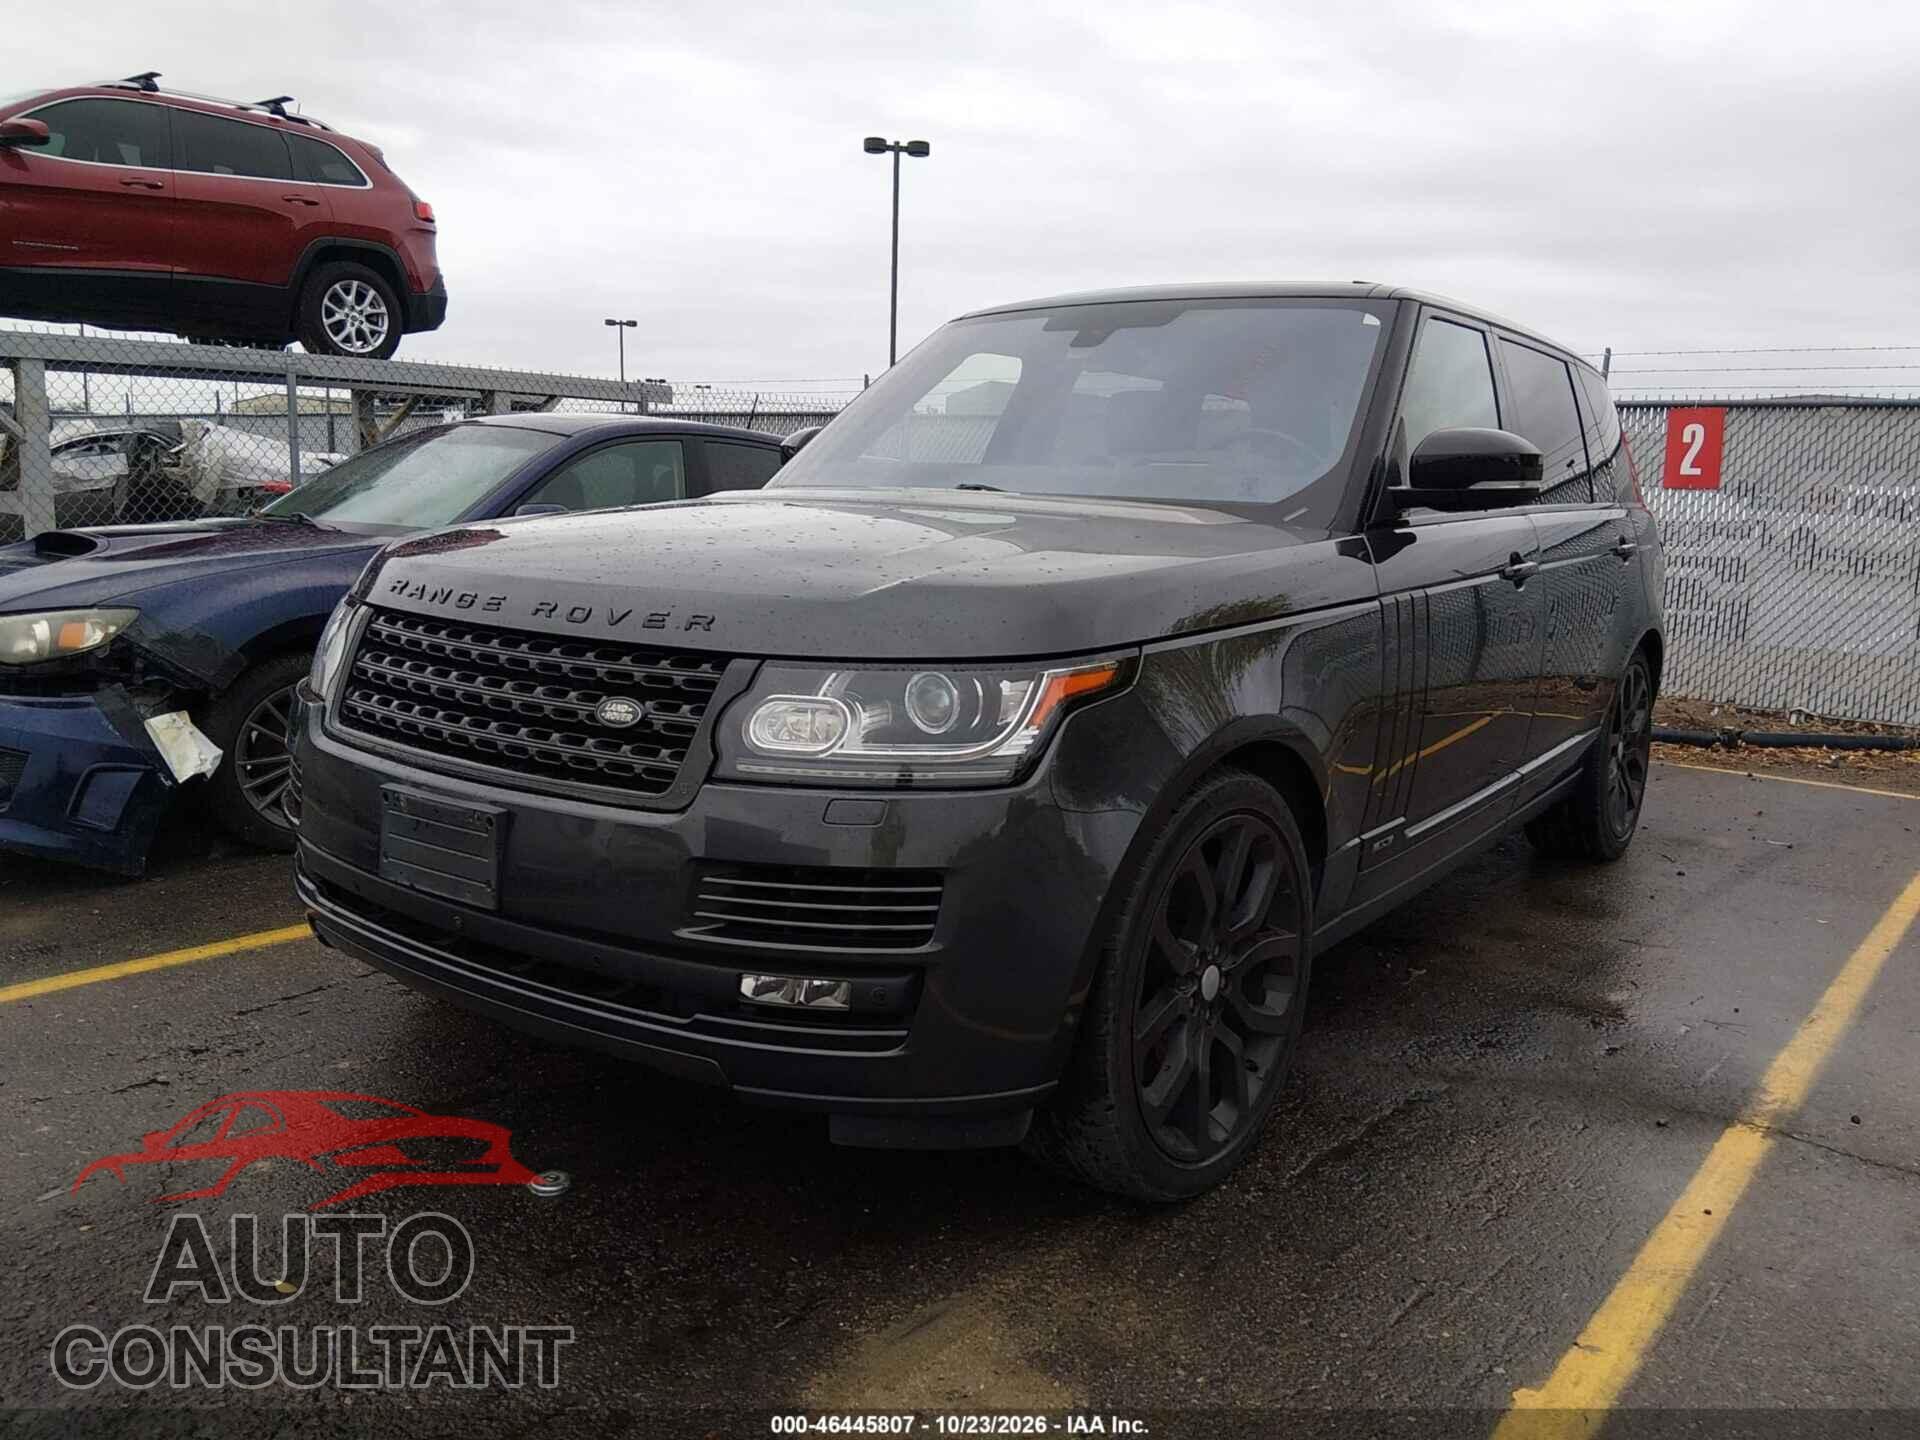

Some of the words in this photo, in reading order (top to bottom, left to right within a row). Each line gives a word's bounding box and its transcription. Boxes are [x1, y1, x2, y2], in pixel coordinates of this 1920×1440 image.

[1679, 423, 1705, 475] 2
[389, 580, 507, 613] RANGE
[531, 601, 716, 632] ROVER
[604, 702, 629, 712] LAND
[604, 711, 633, 721] ROVER
